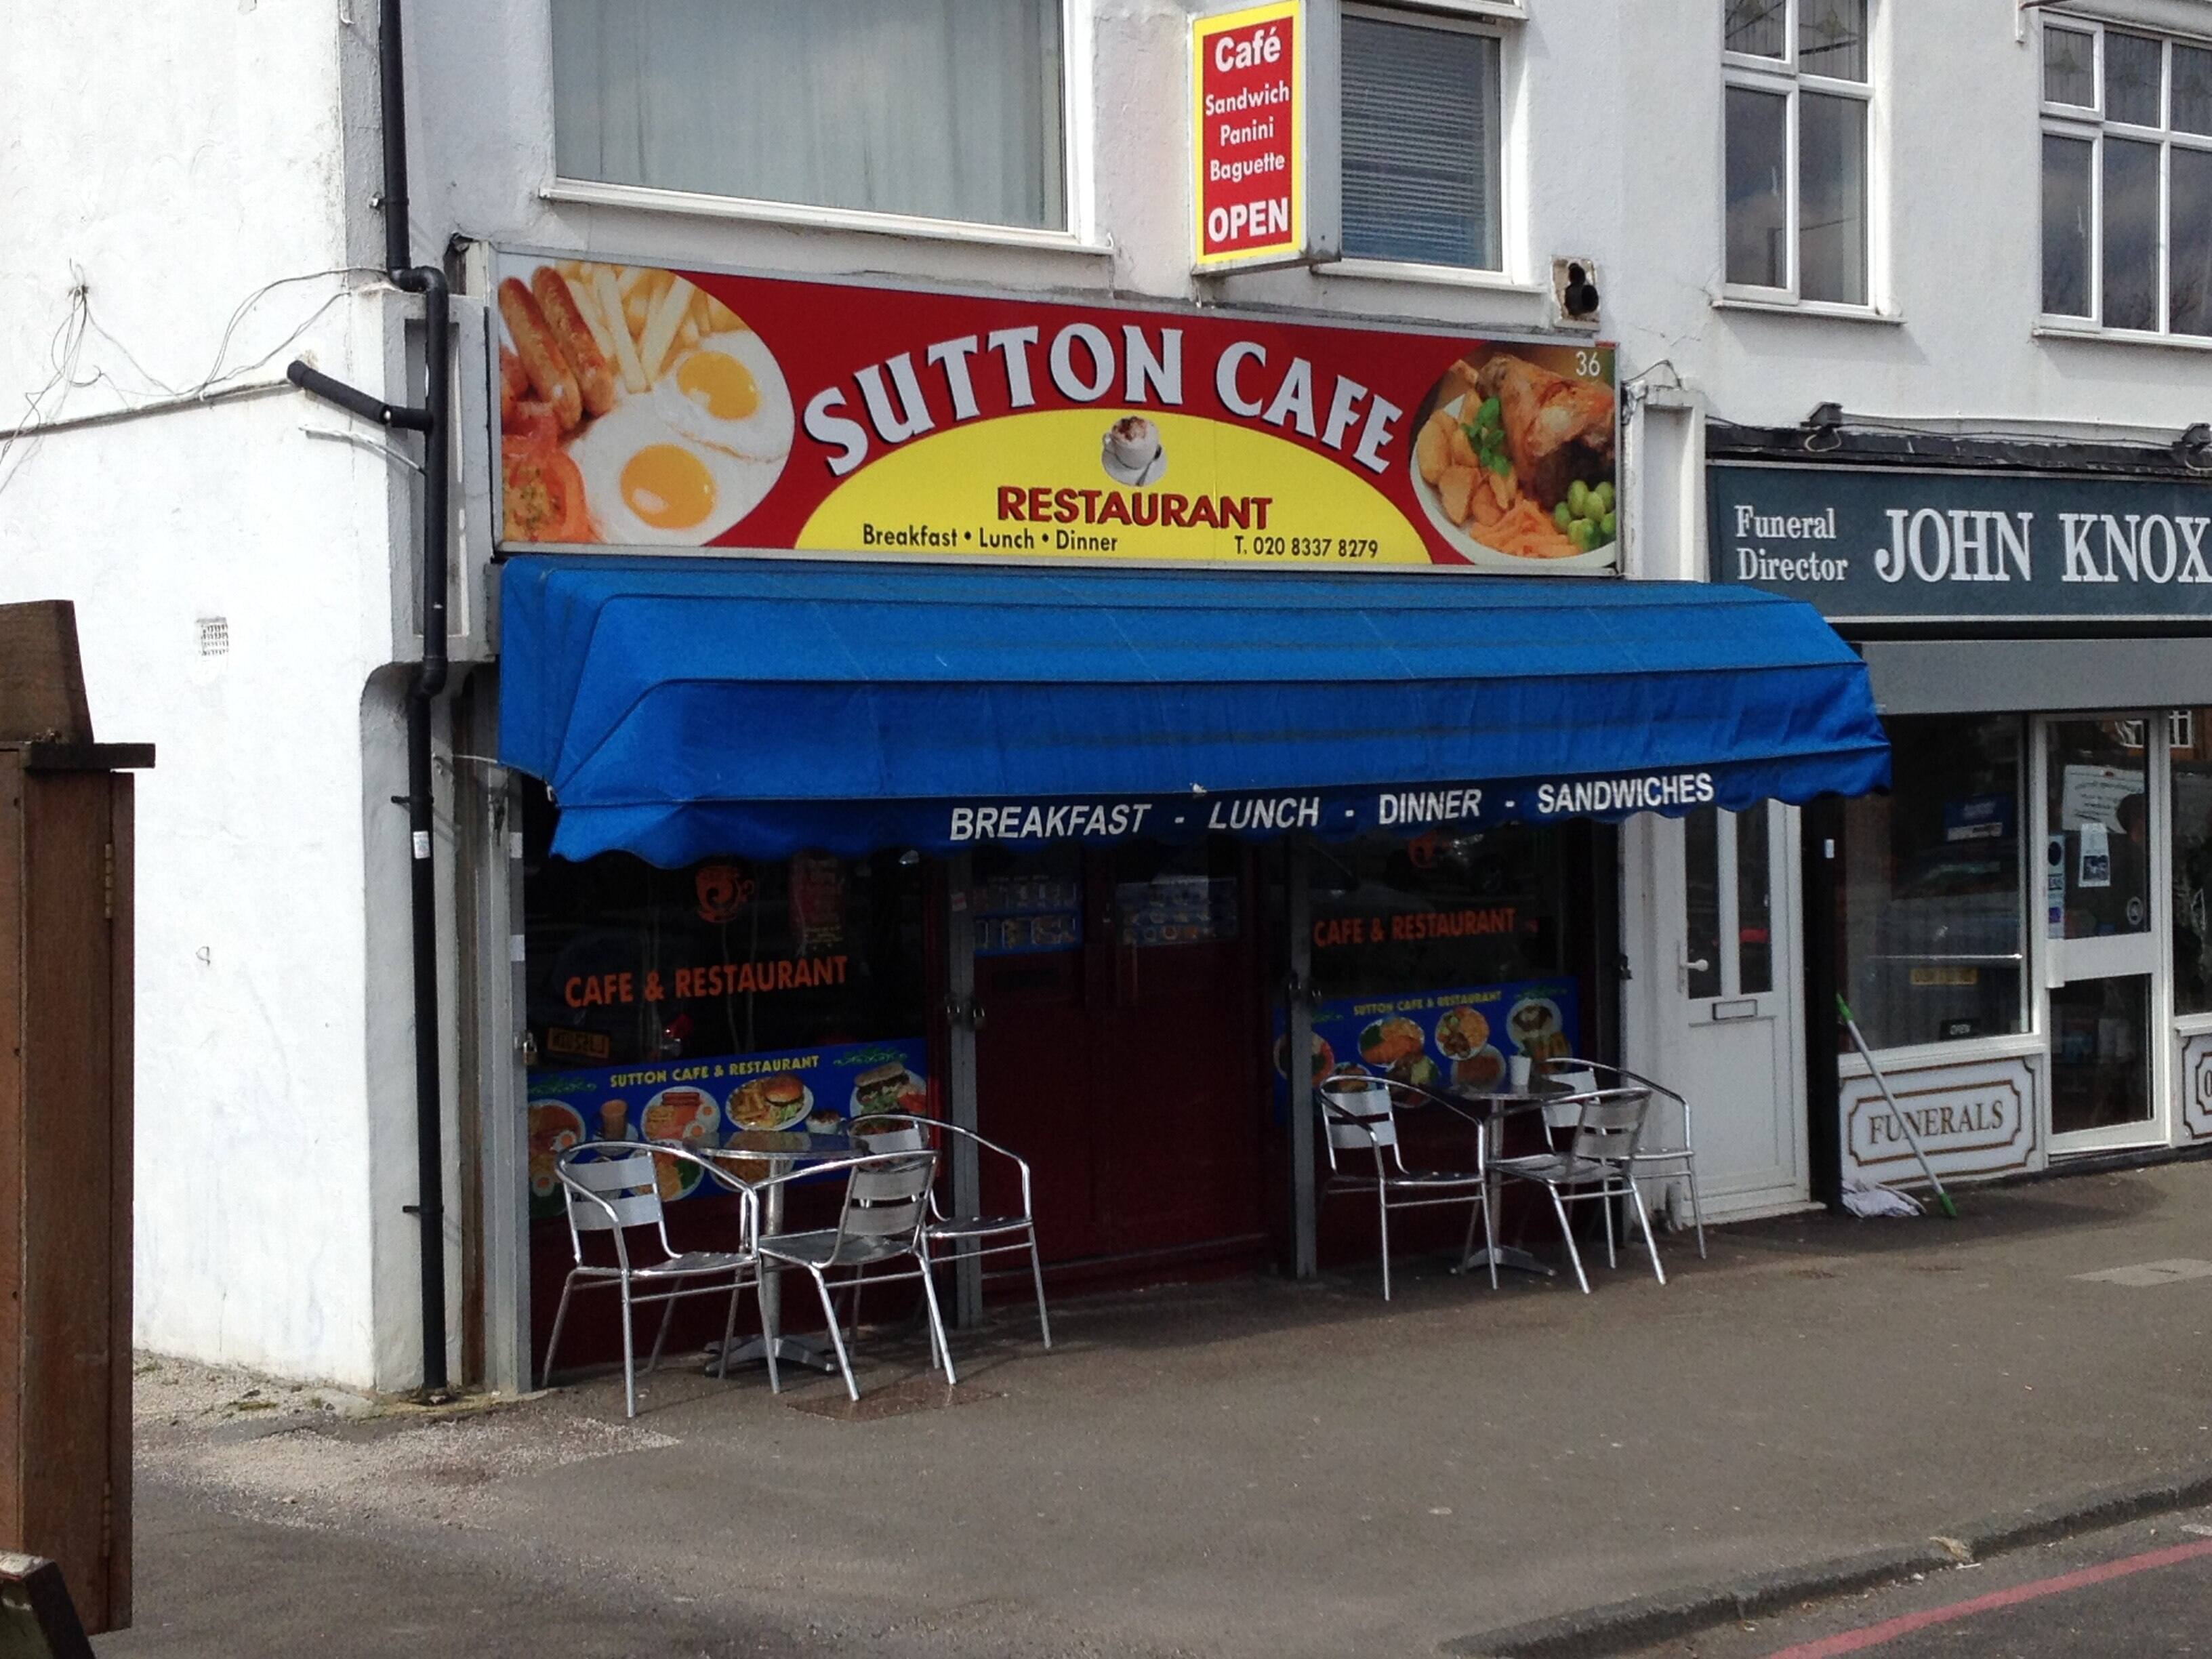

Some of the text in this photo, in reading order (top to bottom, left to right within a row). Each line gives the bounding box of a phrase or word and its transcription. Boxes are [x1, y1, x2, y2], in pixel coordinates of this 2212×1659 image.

[1215, 26, 1281, 73] Café
[1206, 80, 1290, 116] Sandwich
[1221, 117, 1274, 146] Panini
[1210, 152, 1285, 183] Baguette
[1208, 197, 1288, 243] OPEN
[1576, 350, 1600, 377] 36
[804, 323, 1403, 476] SUTTON CAFE
[998, 486, 1273, 530] RESTAURANT
[1734, 504, 1837, 539] Funeral
[863, 523, 1118, 552] Breakfast Lunch Dinner
[1234, 535, 1378, 558] T. 020 8337 8279
[1874, 508, 2212, 585] JOHN KNOX
[1736, 548, 1849, 581] Director
[950, 804, 1152, 840] BREAKFAST
[1209, 797, 1320, 829] LUNCH
[1379, 789, 1482, 825] DINNER
[1538, 773, 1714, 814] SANDWICHES
[1313, 907, 1518, 948] CAFE & RESTAURANT
[564, 955, 849, 1008] CAFE & RESTAURANT
[1353, 1002, 1394, 1016] SUTTON
[610, 1055, 819, 1088] SUTTON CAFE & RESTAURANT
[1869, 1100, 2005, 1145] FUNERALS
